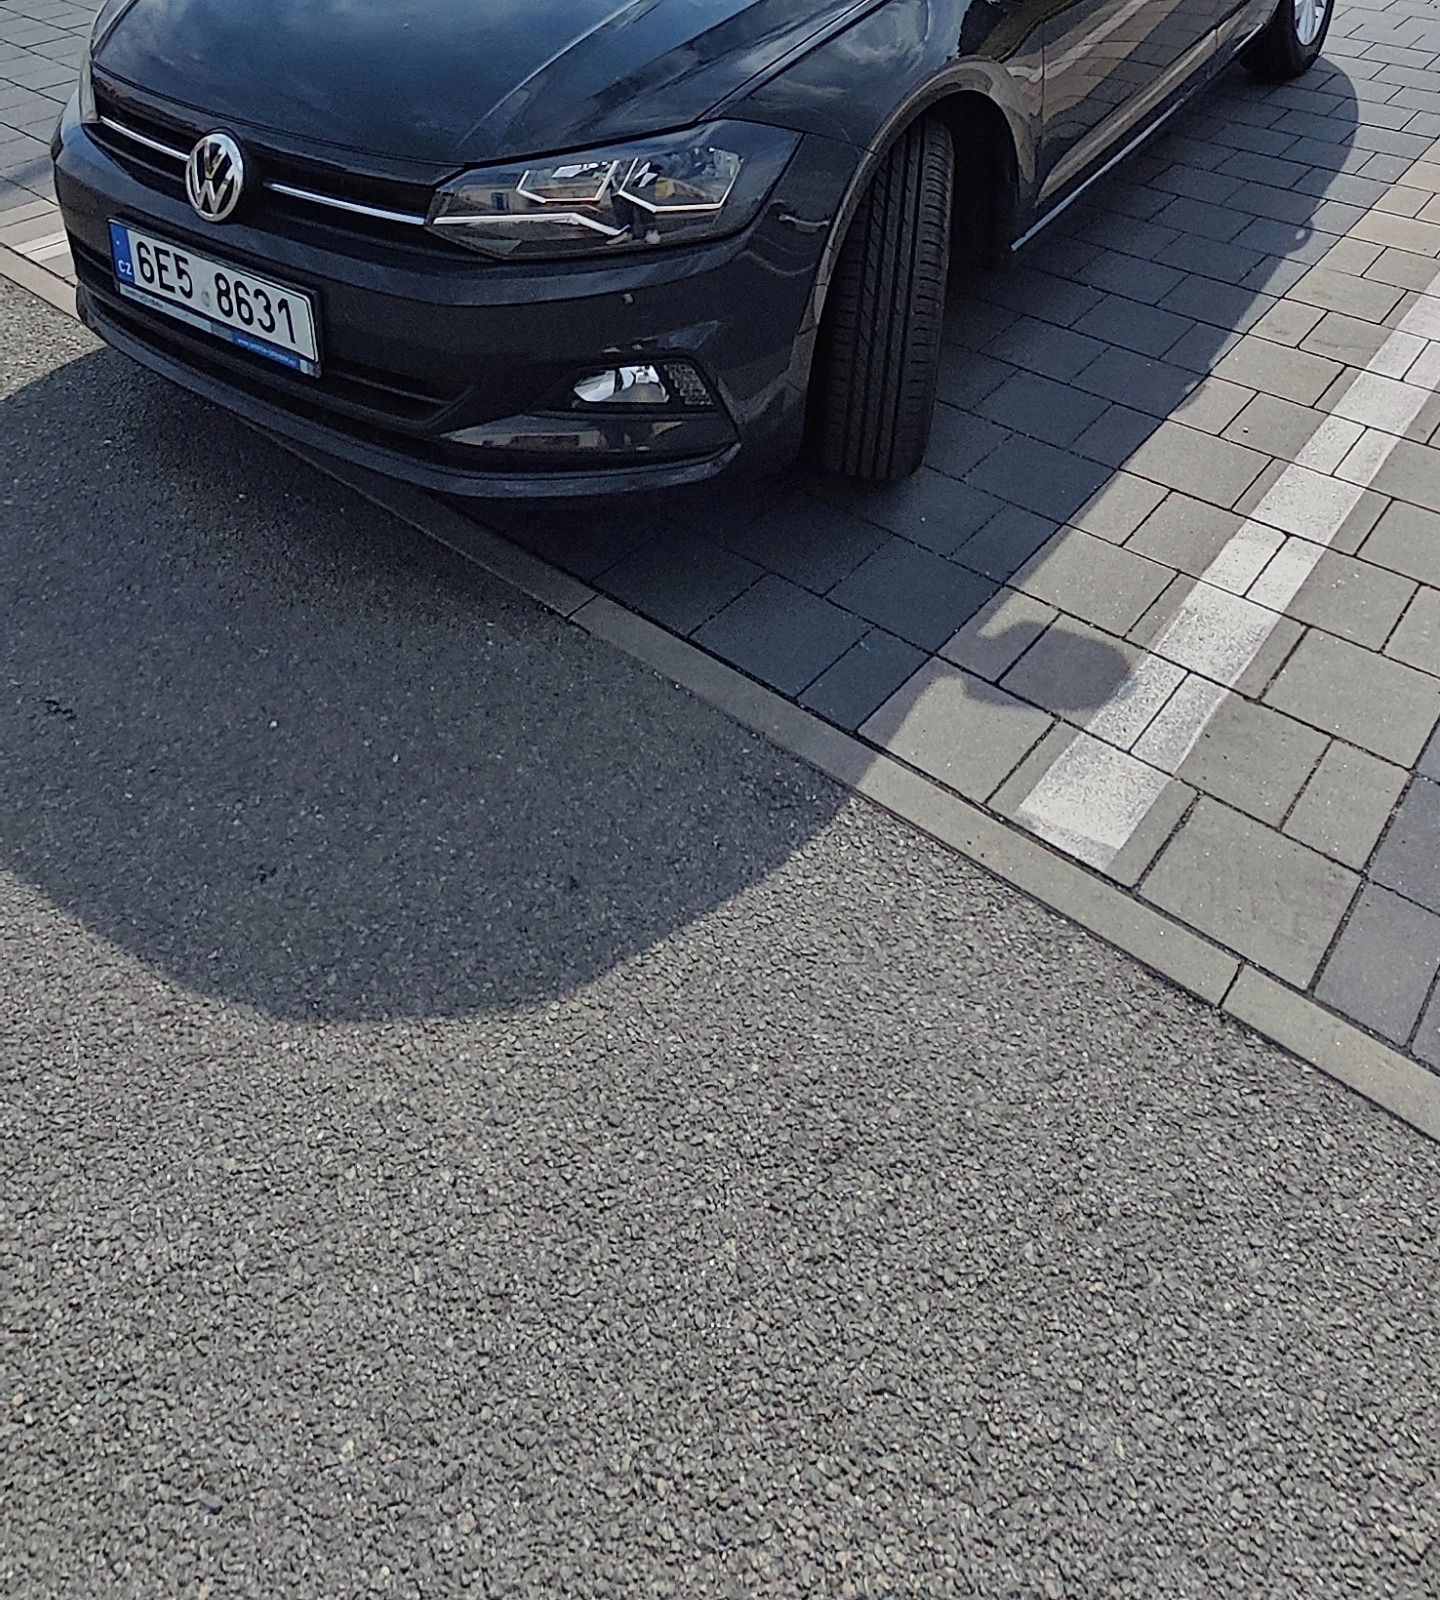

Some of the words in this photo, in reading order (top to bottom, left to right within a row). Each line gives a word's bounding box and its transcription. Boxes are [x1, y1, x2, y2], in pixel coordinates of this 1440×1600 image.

[118, 260, 133, 276] CZ
[136, 241, 193, 299] 6E5
[214, 272, 296, 344] 8631
